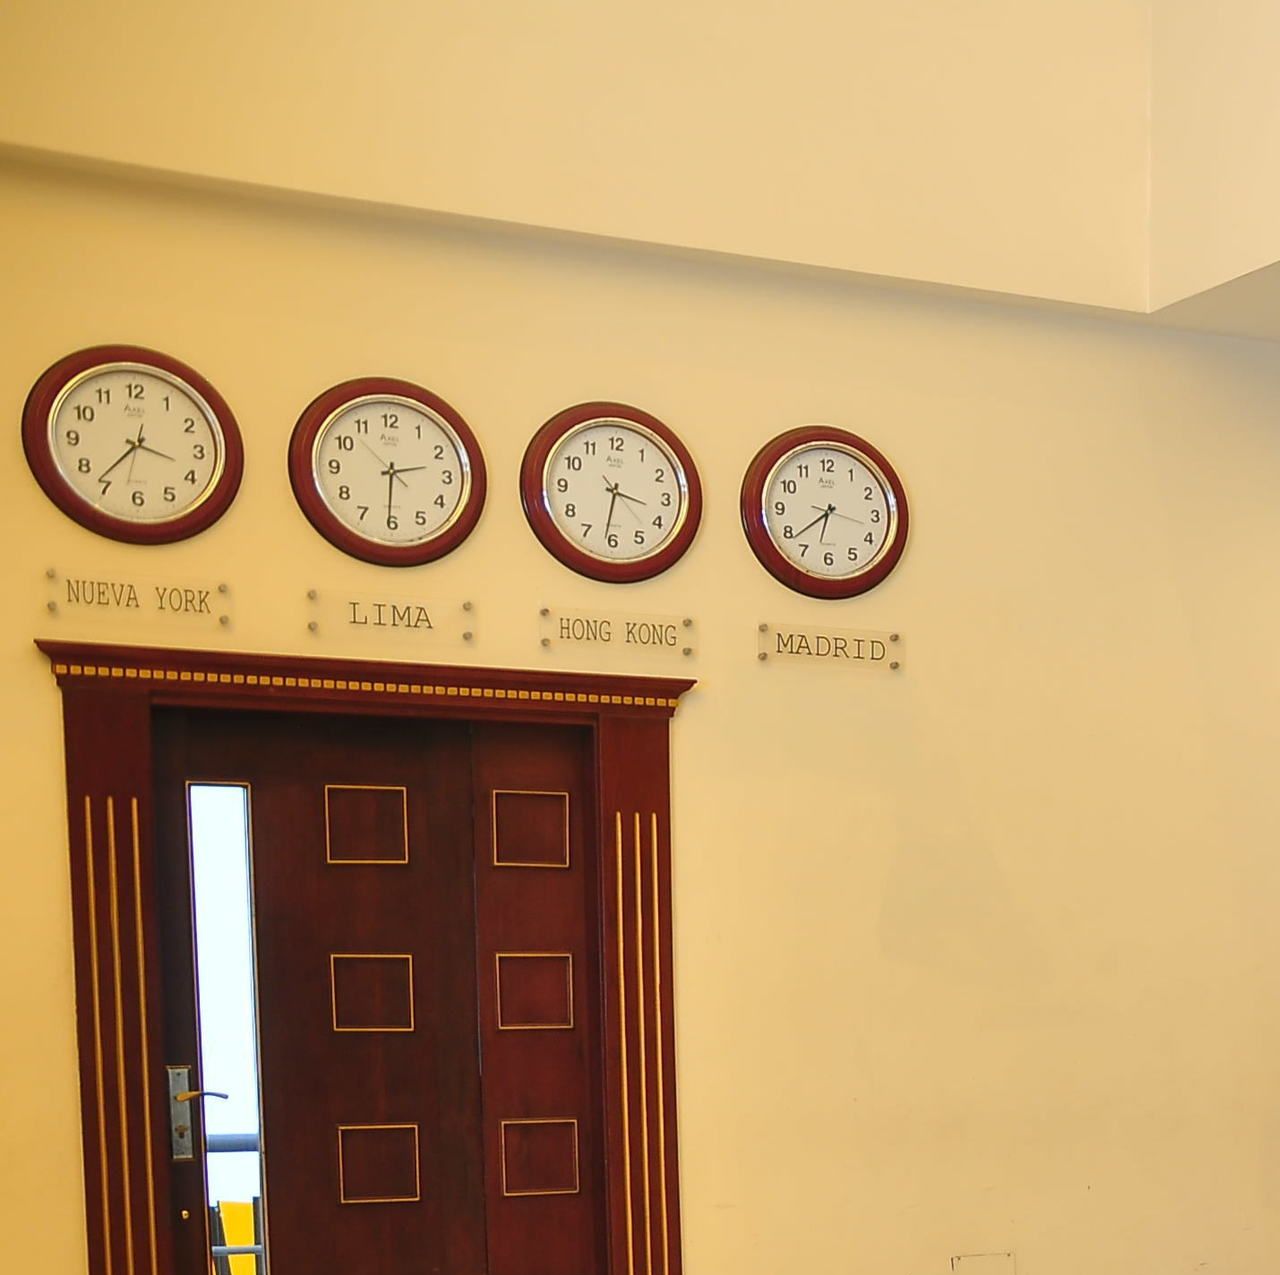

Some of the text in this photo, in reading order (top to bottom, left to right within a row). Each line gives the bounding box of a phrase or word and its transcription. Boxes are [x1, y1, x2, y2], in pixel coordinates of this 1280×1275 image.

[96, 388, 110, 404] 11
[126, 384, 144, 399] 12
[163, 396, 169, 411] 1
[74, 405, 94, 422] 10
[184, 418, 195, 433] 2
[355, 419, 368, 434] 11
[382, 414, 398, 429] 12
[66, 430, 79, 446] 9
[416, 425, 421, 439] 1
[335, 435, 353, 451] 10
[584, 441, 596, 455] 11
[609, 437, 624, 451] 12
[193, 445, 205, 460] 3
[434, 445, 444, 460] 2
[639, 449, 644, 462] 1
[78, 458, 91, 473] 8
[328, 459, 340, 474] 9
[565, 456, 582, 471] 10
[820, 459, 834, 472] 12
[184, 470, 196, 485] 4
[442, 470, 452, 485] 3
[655, 469, 664, 483] 2
[797, 464, 808, 478] 11
[848, 469, 853, 482] 1
[99, 480, 112, 496] 7
[339, 485, 350, 500] 8
[557, 478, 568, 493] 9
[781, 480, 796, 494] 10
[132, 491, 144, 506] 6
[163, 487, 175, 502] 5
[661, 493, 671, 506] 3
[864, 487, 873, 500] 2
[434, 494, 445, 508] 4
[357, 506, 369, 520] 7
[565, 504, 576, 517] 8
[775, 502, 785, 515] 9
[387, 515, 398, 530] 6
[415, 511, 426, 525] 5
[652, 515, 663, 529] 4
[871, 510, 880, 523] 3
[581, 523, 592, 537] 7
[634, 530, 645, 544] 5
[783, 526, 793, 539] 8
[608, 534, 618, 548] 6
[864, 532, 873, 545] 4
[799, 544, 809, 557] 7
[848, 548, 857, 561] 5
[824, 552, 833, 566] 6
[66, 578, 211, 614] NUEVA YORK
[348, 601, 433, 629] LIMA
[559, 617, 677, 646] HONG KONG
[776, 632, 886, 661] MADRID
